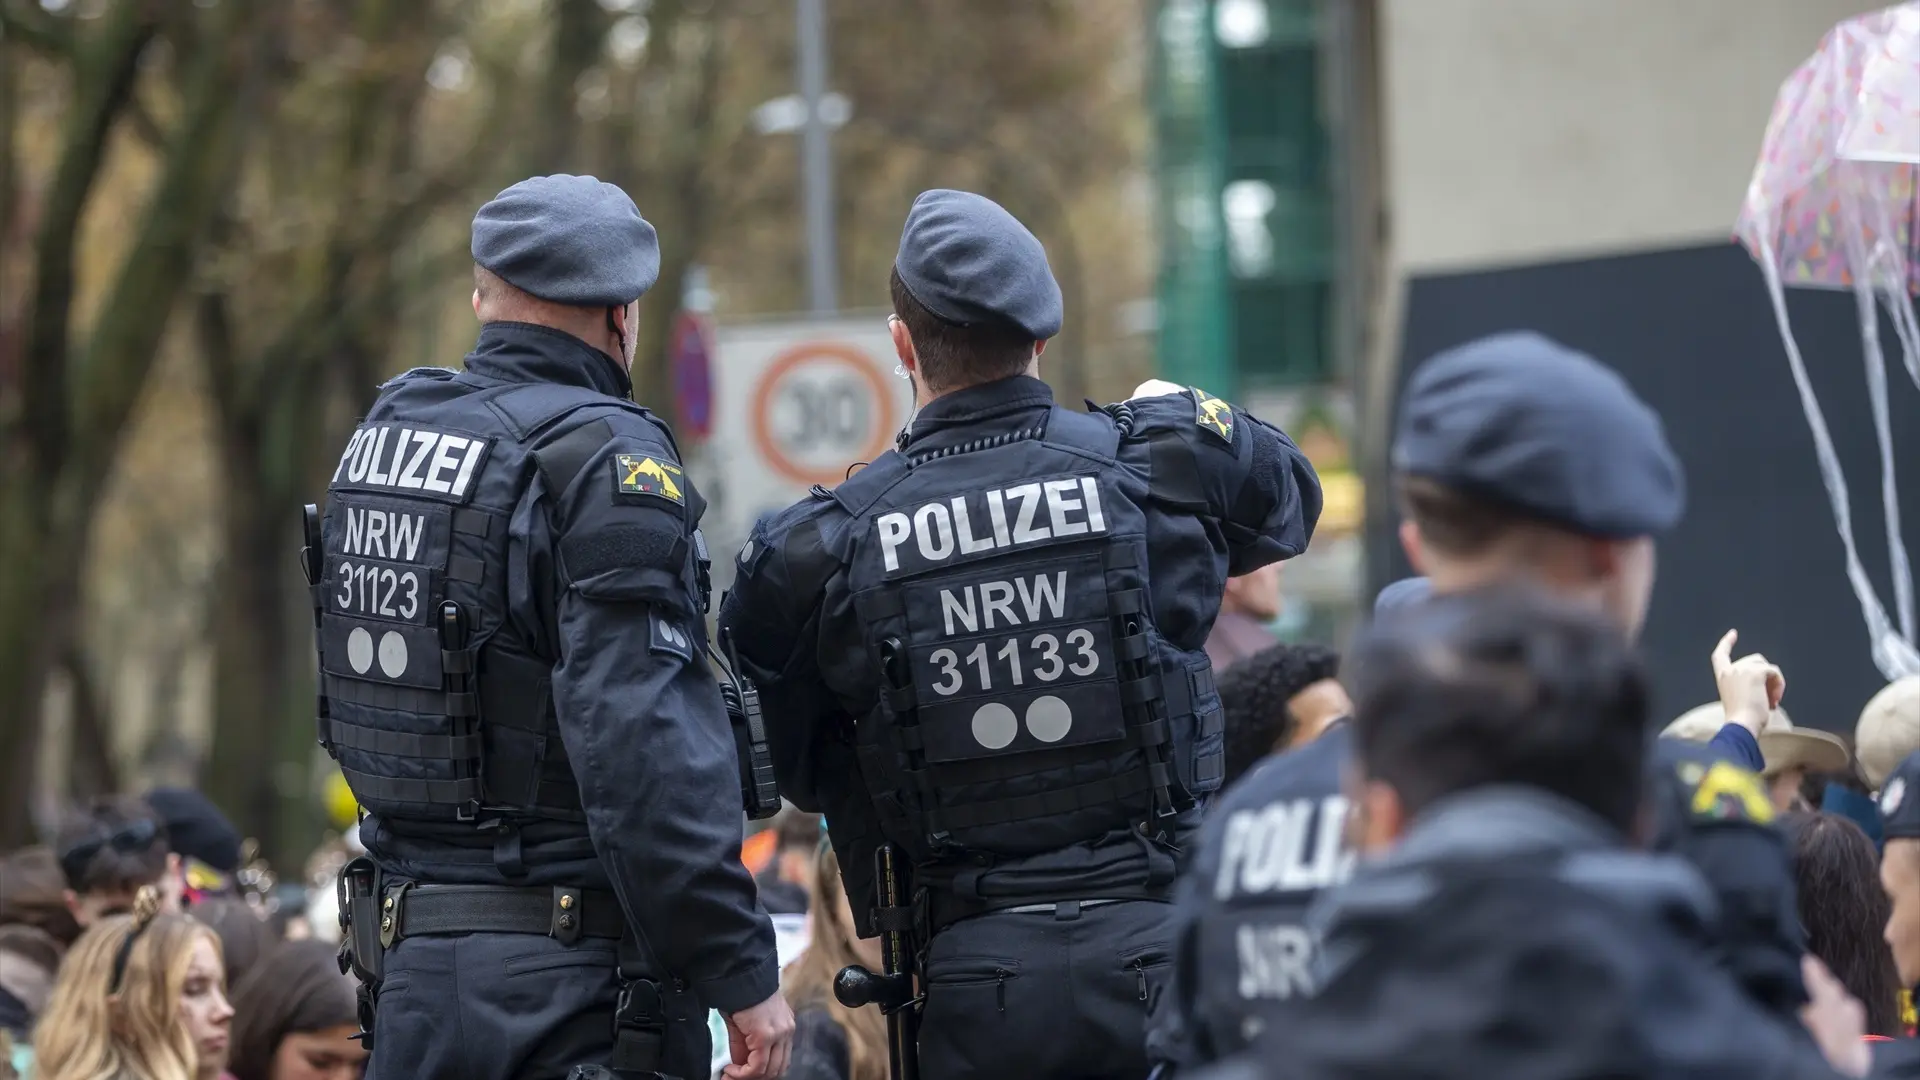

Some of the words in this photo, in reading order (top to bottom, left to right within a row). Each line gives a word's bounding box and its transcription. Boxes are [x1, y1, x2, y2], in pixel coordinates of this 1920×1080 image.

[786, 377, 868, 451] 30
[332, 427, 485, 496] POLIZEI
[343, 507, 424, 560] NRW
[877, 477, 1106, 571] POLIZEI
[337, 562, 418, 619] 31123
[940, 571, 1067, 635] NRW
[929, 629, 1099, 696] 31133
[1214, 796, 1356, 899] POLI
[1237, 924, 1314, 1000] NR
